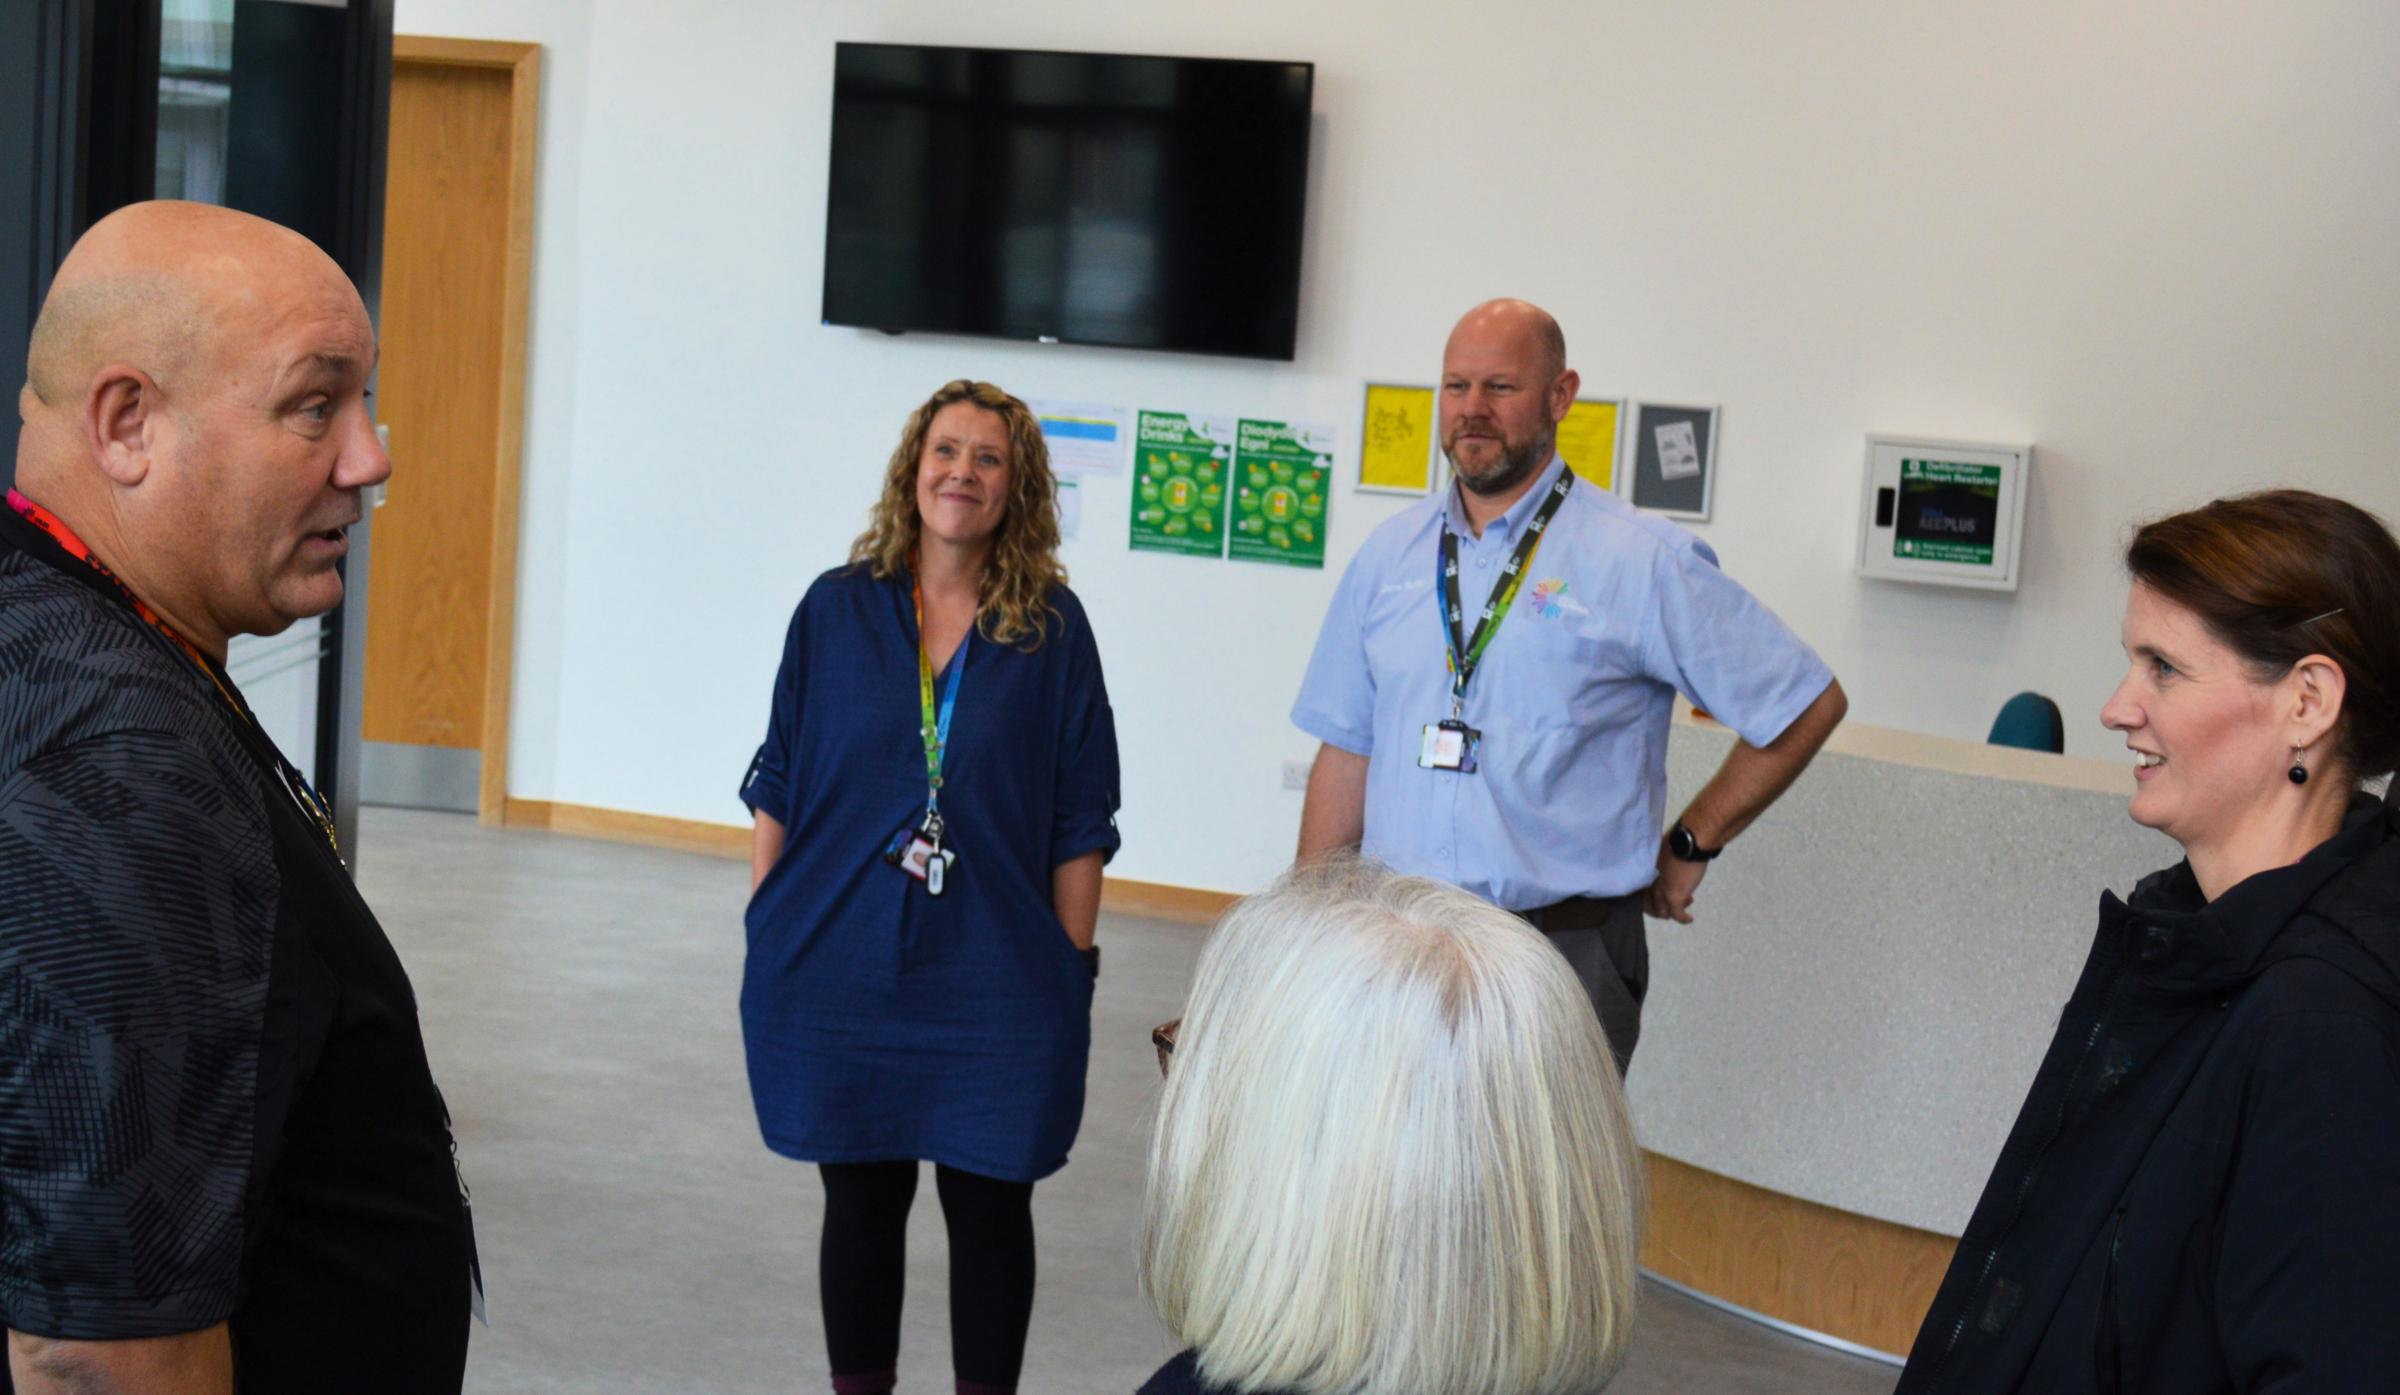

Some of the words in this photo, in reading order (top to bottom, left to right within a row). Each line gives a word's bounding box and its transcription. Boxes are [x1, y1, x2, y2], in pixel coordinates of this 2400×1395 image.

[1141, 414, 1188, 432] Energy
[1140, 428, 1184, 444] Drinks
[1926, 462, 1983, 475] Defibrillator
[1926, 473, 1952, 483] Heart
[1954, 475, 1998, 485] Restarter
